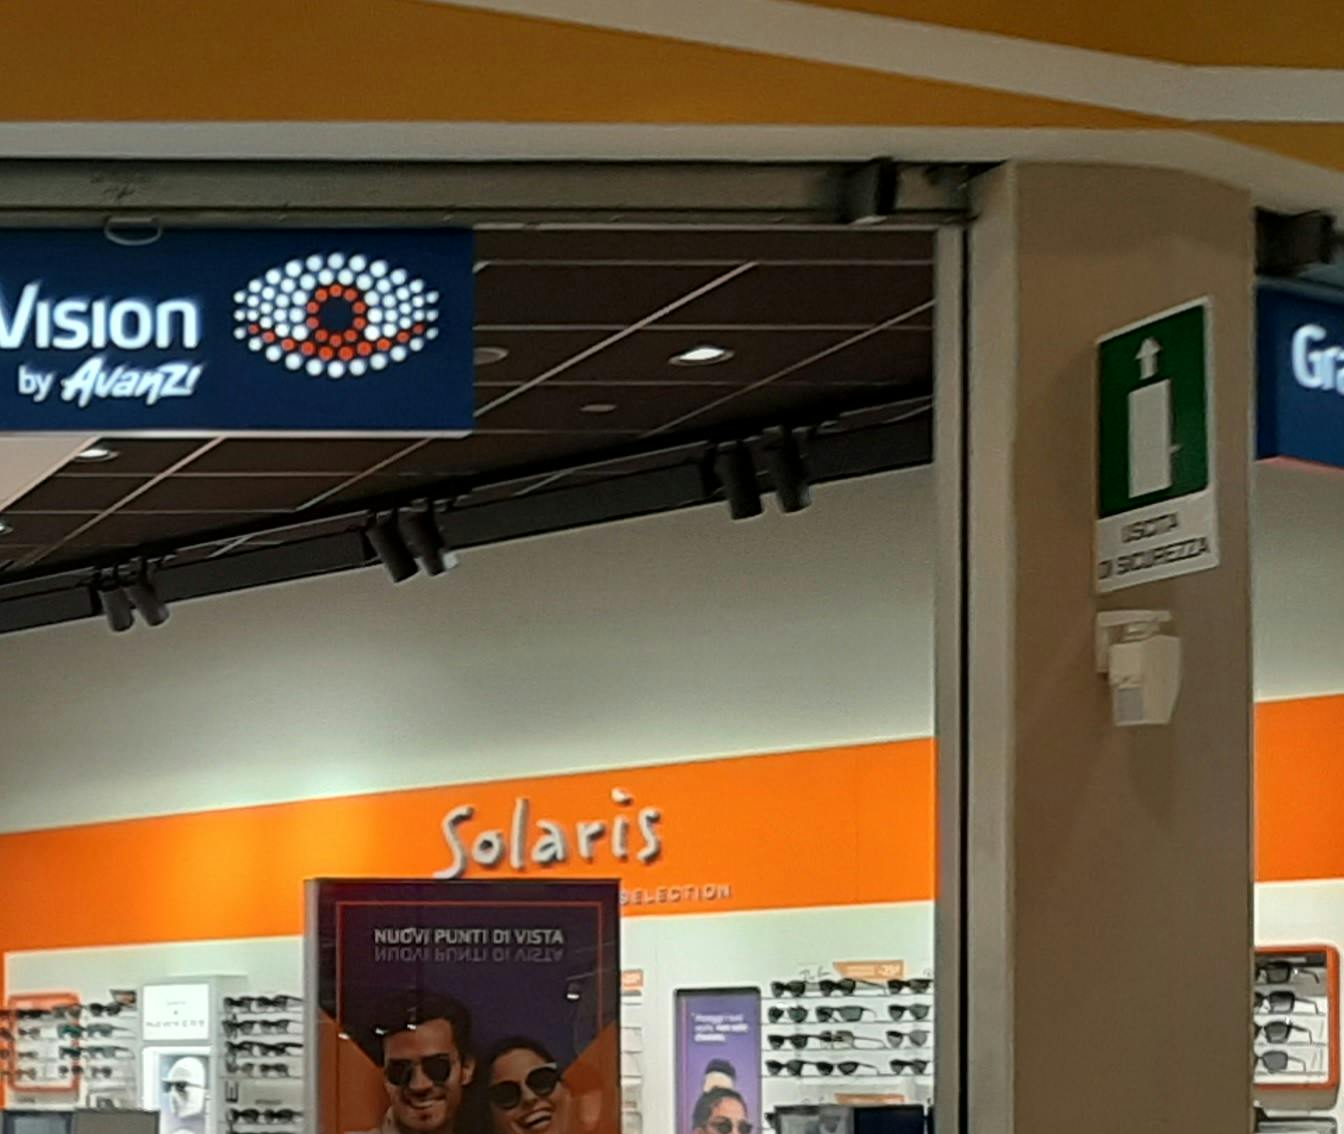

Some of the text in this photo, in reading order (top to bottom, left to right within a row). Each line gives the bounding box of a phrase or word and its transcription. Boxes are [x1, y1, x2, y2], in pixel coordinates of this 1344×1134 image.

[19, 365, 52, 401] by
[433, 787, 661, 879] Solaris
[374, 927, 564, 945] NUOVI PUNTI DI VISTA
